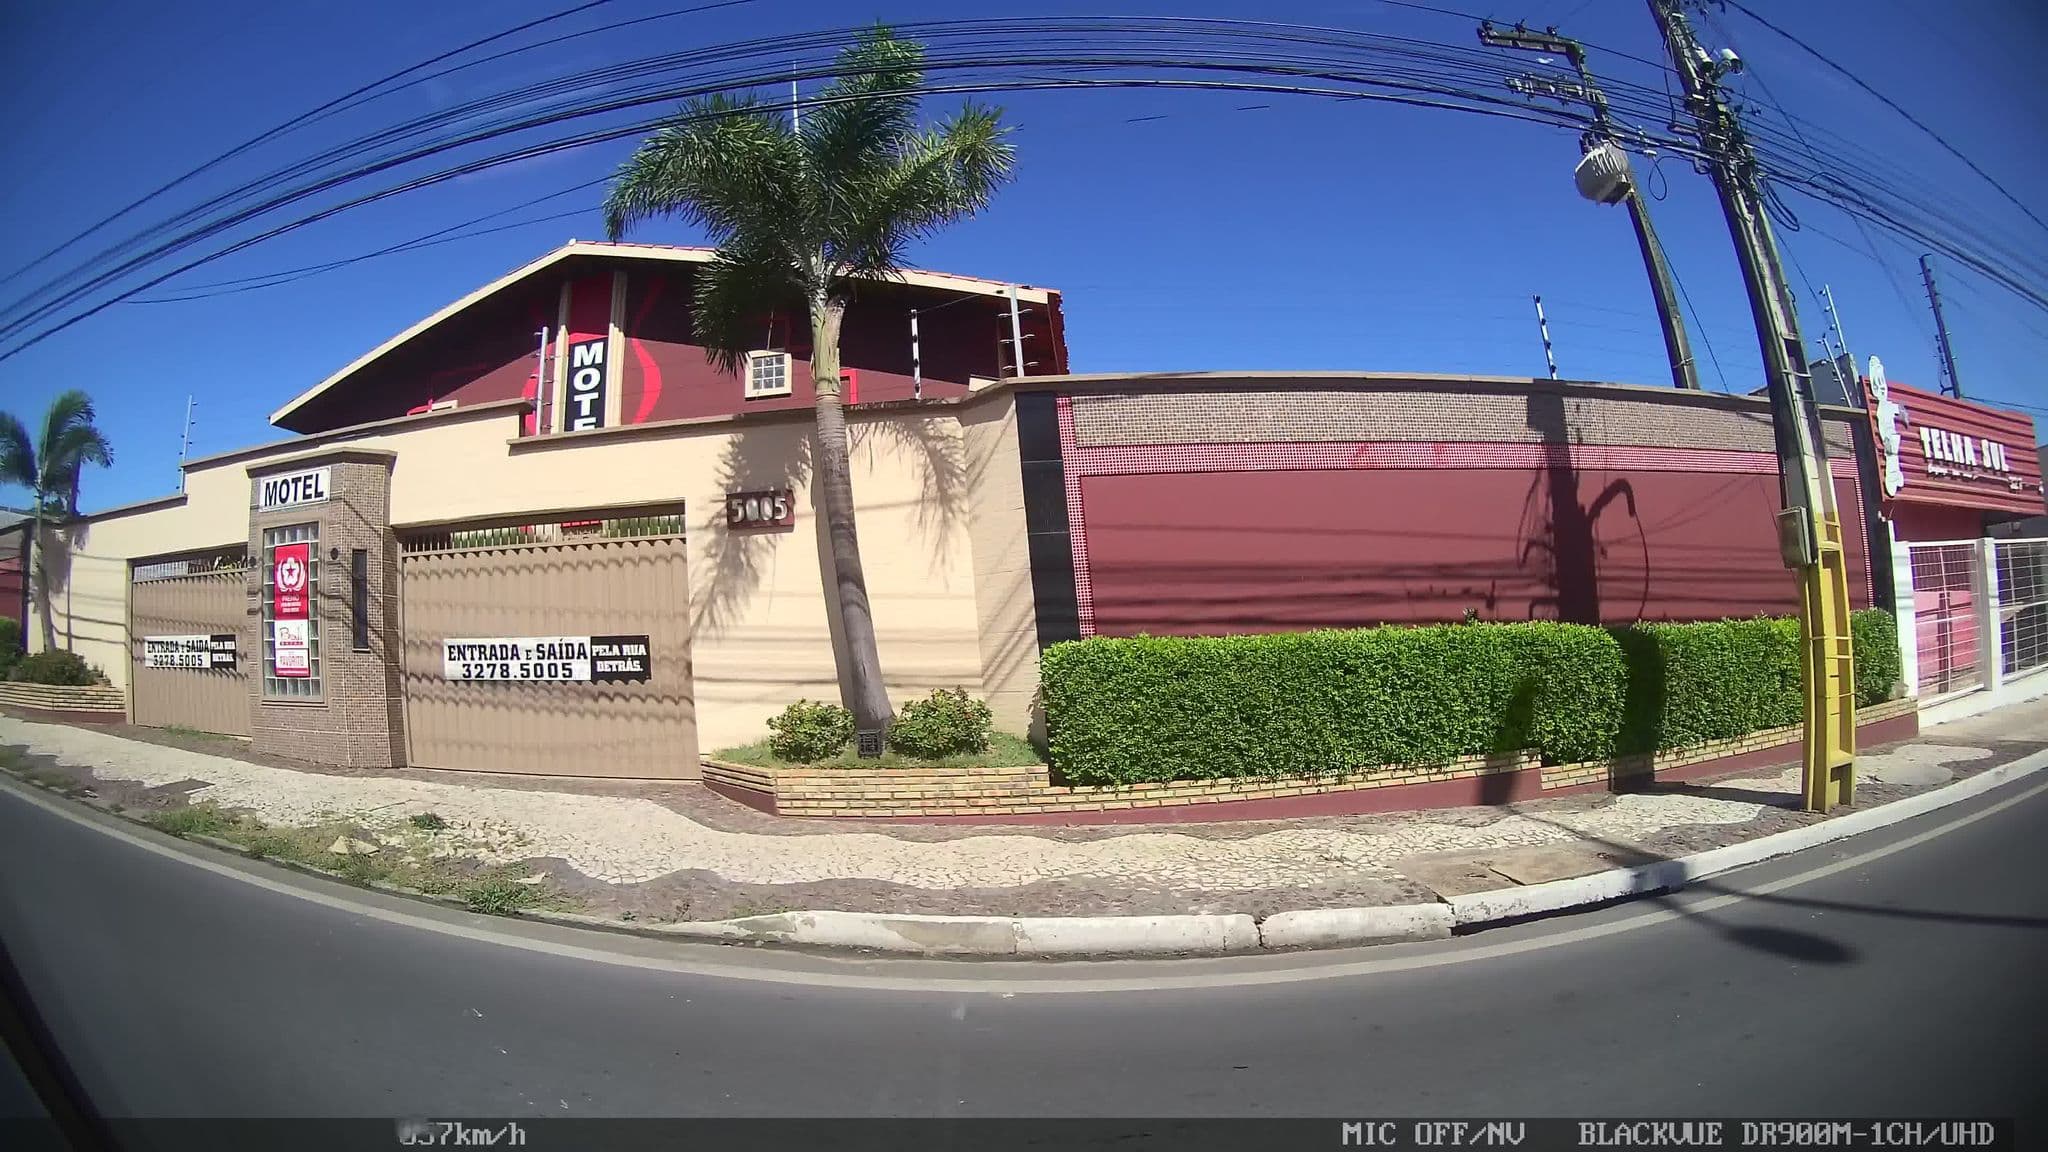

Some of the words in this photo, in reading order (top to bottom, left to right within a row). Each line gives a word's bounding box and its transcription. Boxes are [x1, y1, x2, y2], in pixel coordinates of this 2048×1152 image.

[1919, 427, 1977, 466] TELHA
[1981, 439, 2009, 471] SUL
[264, 473, 324, 506] MOTEL
[731, 496, 788, 523] 5005
[147, 641, 180, 653] ENTRADA
[448, 644, 520, 661] ENTRADA
[525, 649, 533, 660] E
[537, 638, 588, 660] SAÍDA
[592, 644, 620, 656] PELA
[622, 644, 647, 656] RUA
[153, 654, 203, 667] 3278.5005
[462, 663, 573, 678] 3278.5005
